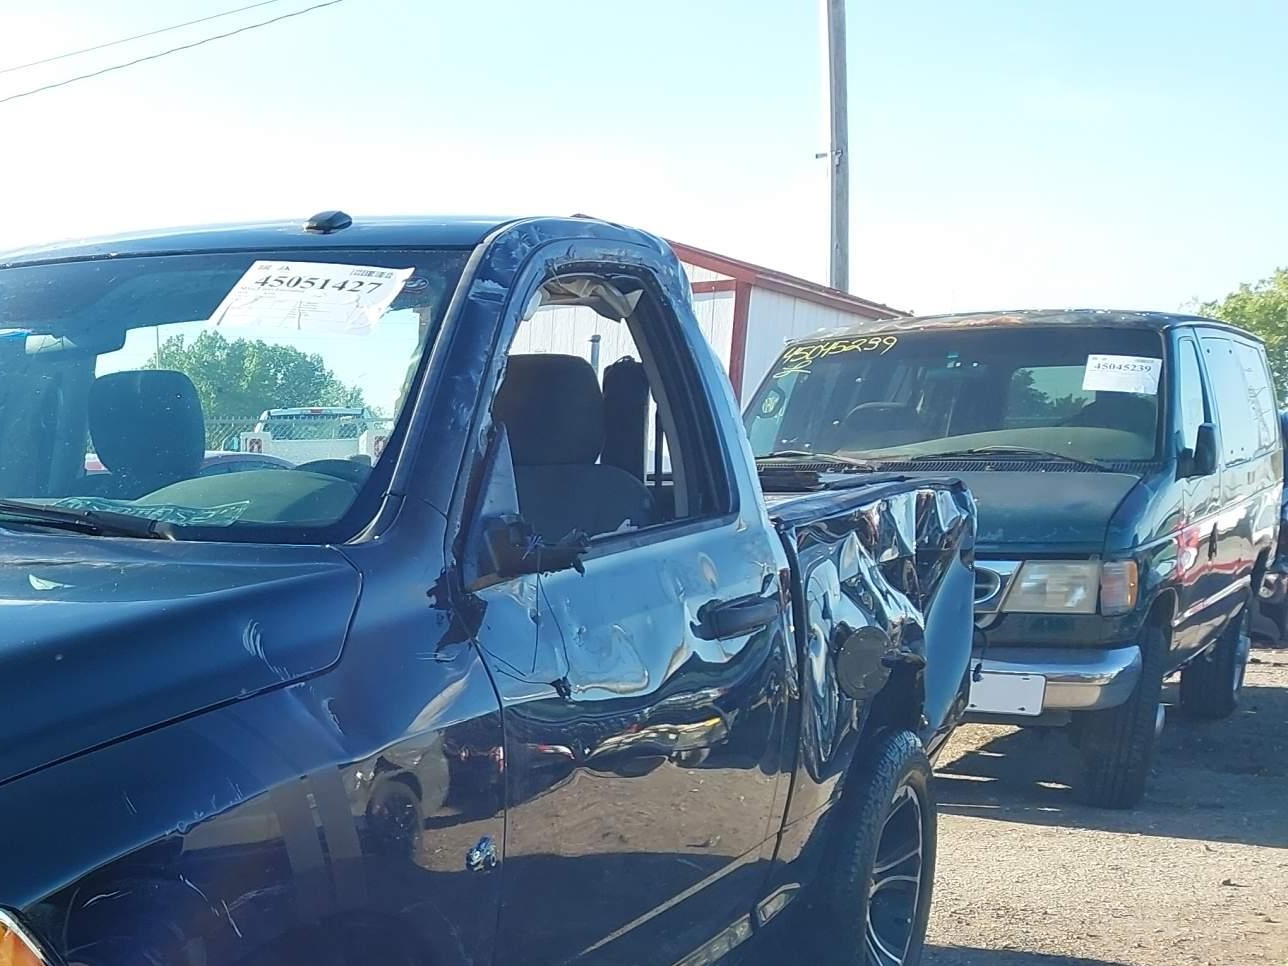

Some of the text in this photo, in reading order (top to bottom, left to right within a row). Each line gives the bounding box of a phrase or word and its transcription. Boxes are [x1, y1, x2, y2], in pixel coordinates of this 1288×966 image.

[255, 274, 383, 294] 45051427
[782, 336, 898, 364] 45045239
[1094, 362, 1152, 373] 45045239
